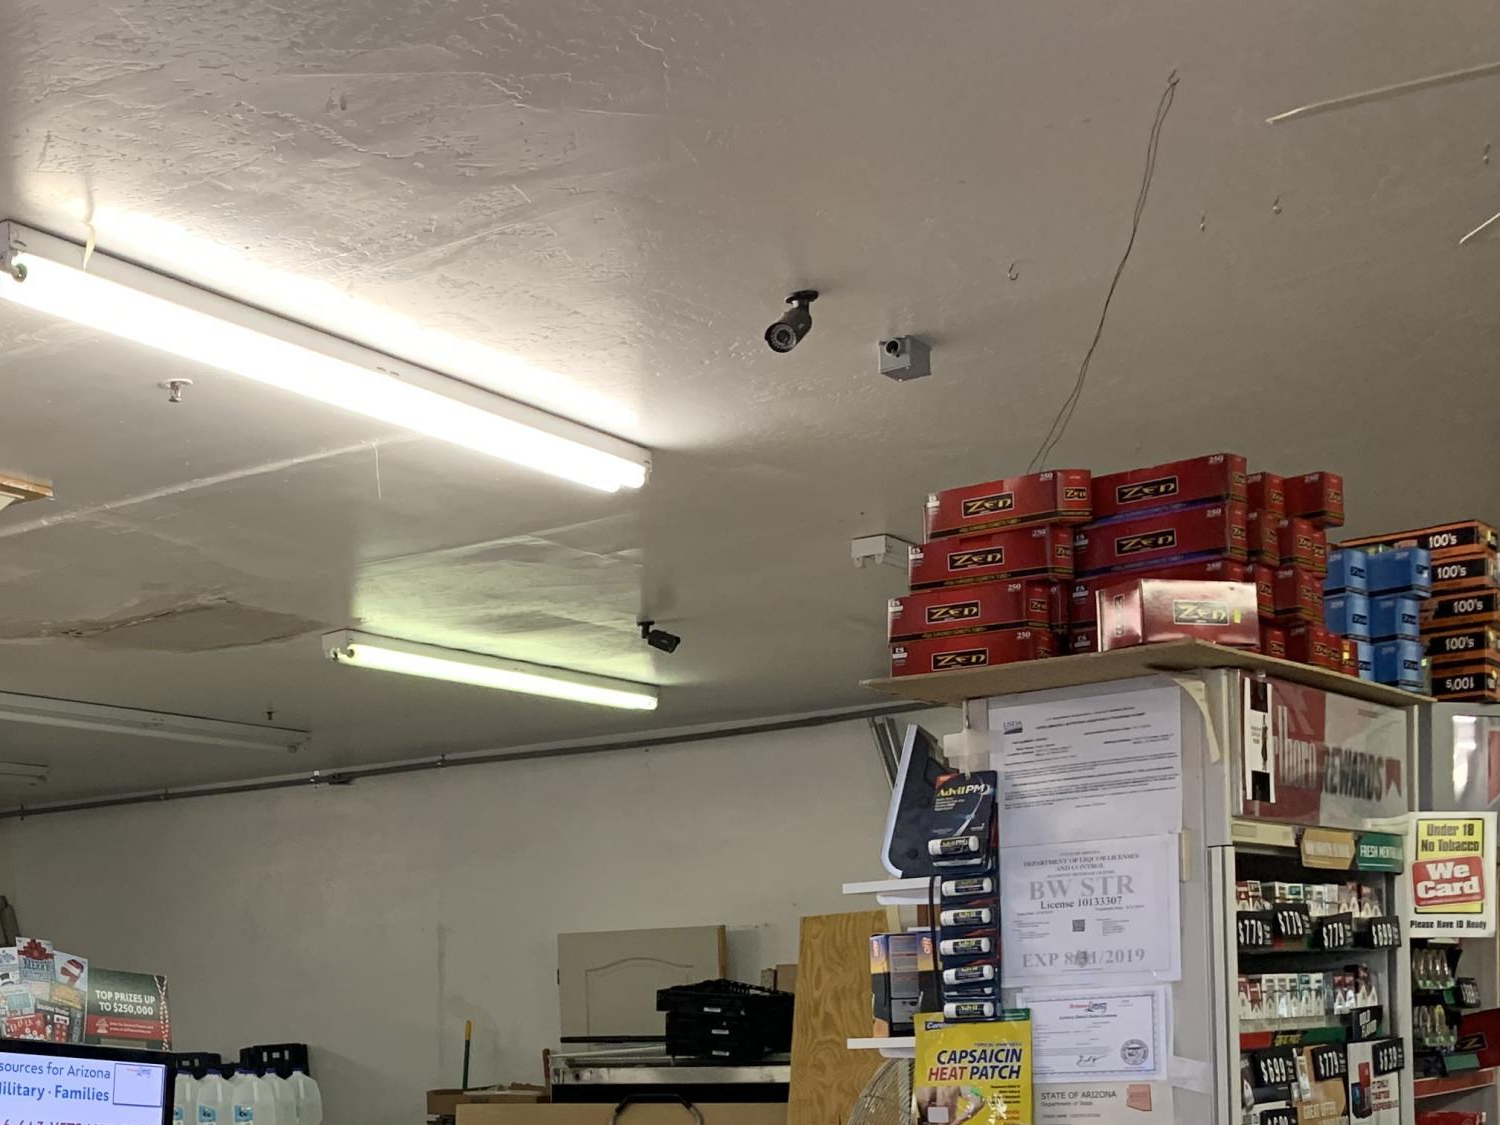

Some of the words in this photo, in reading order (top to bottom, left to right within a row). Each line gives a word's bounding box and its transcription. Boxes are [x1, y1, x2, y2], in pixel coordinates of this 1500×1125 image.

[1426, 823, 1459, 836] Under
[1463, 823, 1474, 836] 18
[1421, 840, 1435, 852] No
[1438, 839, 1480, 852] Tobacco
[1426, 862, 1470, 880] We
[1029, 878, 1073, 901] BW
[1080, 875, 1135, 897] STR
[1416, 877, 1481, 899] Card
[1040, 899, 1074, 910] License
[1410, 920, 1435, 929] Please
[1022, 953, 1059, 968] EXP
[95, 989, 113, 1000] TOP
[114, 991, 144, 1004] PRIZES
[144, 994, 156, 1005] UP
[99, 1001, 112, 1012] TO
[112, 1002, 154, 1016] $250,000
[936, 1048, 1023, 1065] CAPSAICIN
[46, 1062, 64, 1077] for
[66, 1063, 111, 1080] Arizona
[928, 1066, 968, 1081] HEAT
[969, 1065, 1021, 1081] PATCH
[54, 1084, 109, 1102] Families
[1041, 1091, 1067, 1100] STATE
[1068, 1090, 1079, 1099] OF
[1080, 1090, 1117, 1099] ARIZONA
